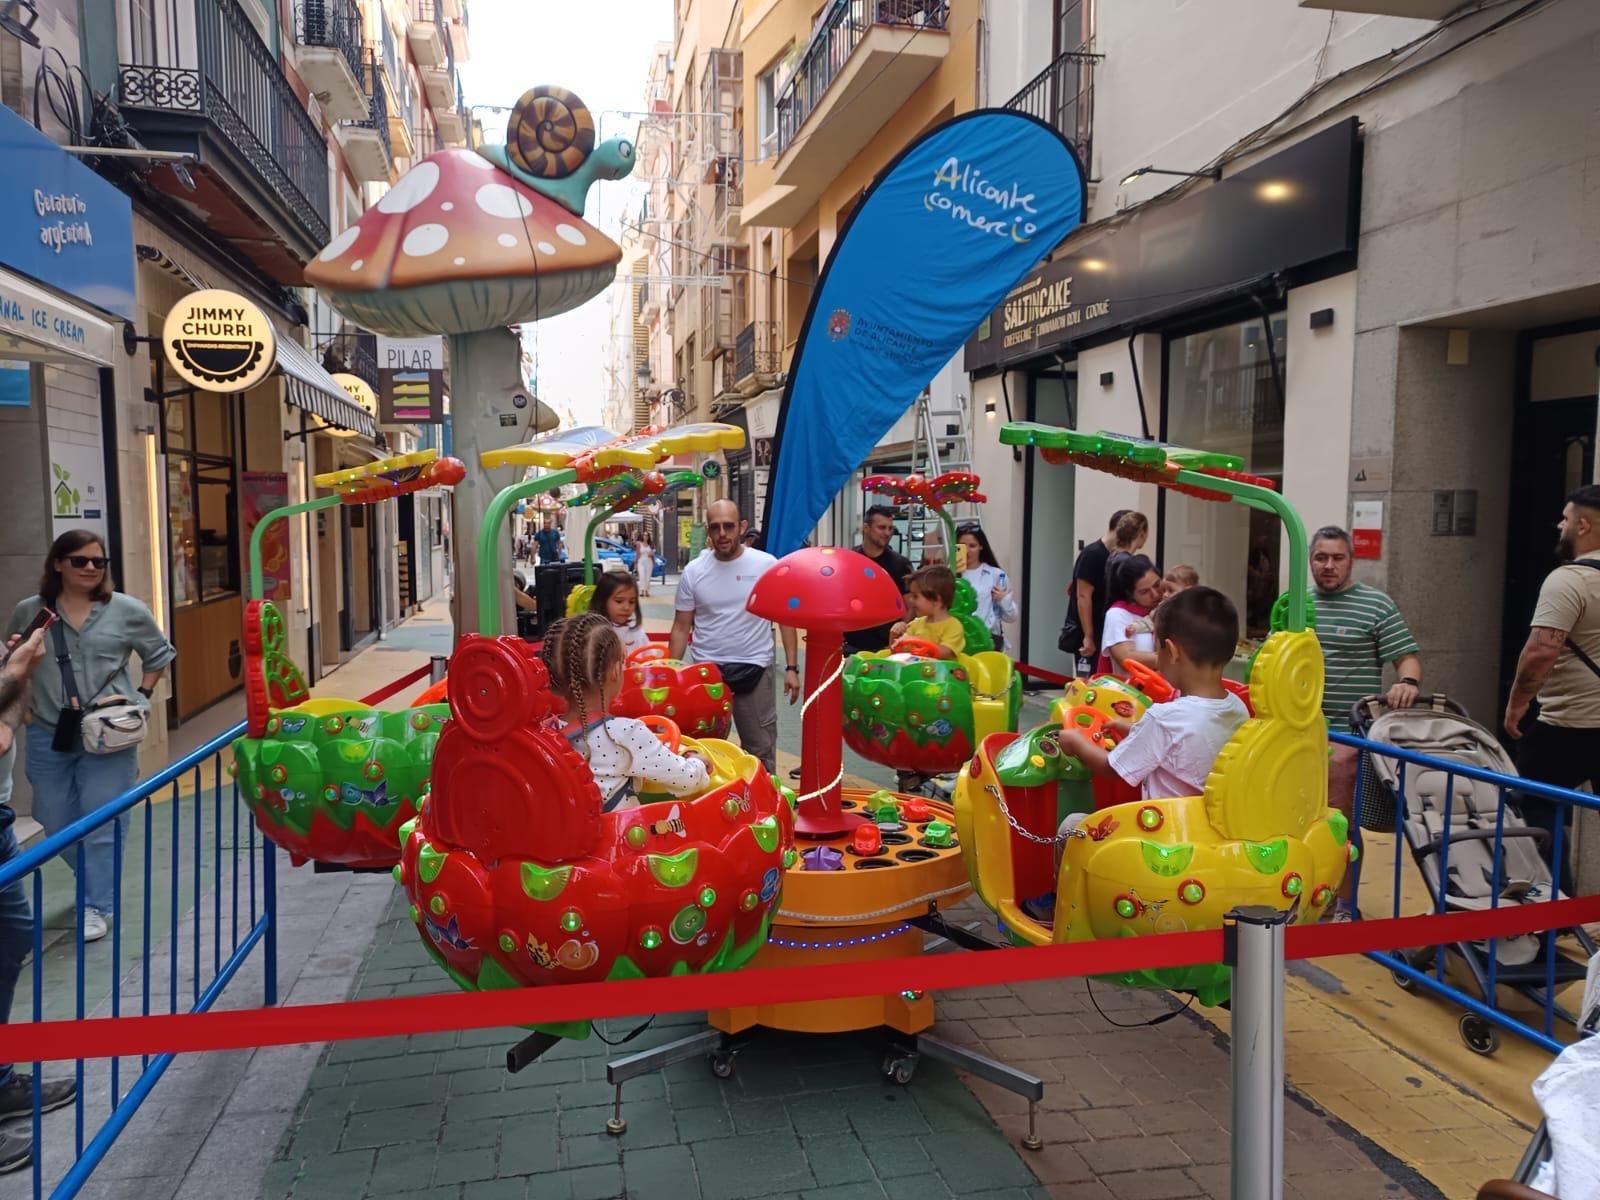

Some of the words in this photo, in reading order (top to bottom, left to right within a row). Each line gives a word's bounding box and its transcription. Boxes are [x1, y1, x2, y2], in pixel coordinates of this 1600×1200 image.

[933, 156, 1038, 213] Alicante
[925, 191, 1037, 243] comercio
[187, 307, 245, 321] JIMMY
[1004, 276, 1073, 331] SALTINCAKE
[31, 308, 48, 329] ICE
[53, 316, 85, 344] CREAM
[182, 322, 252, 337] CHURRI
[387, 348, 432, 370] PILAR
